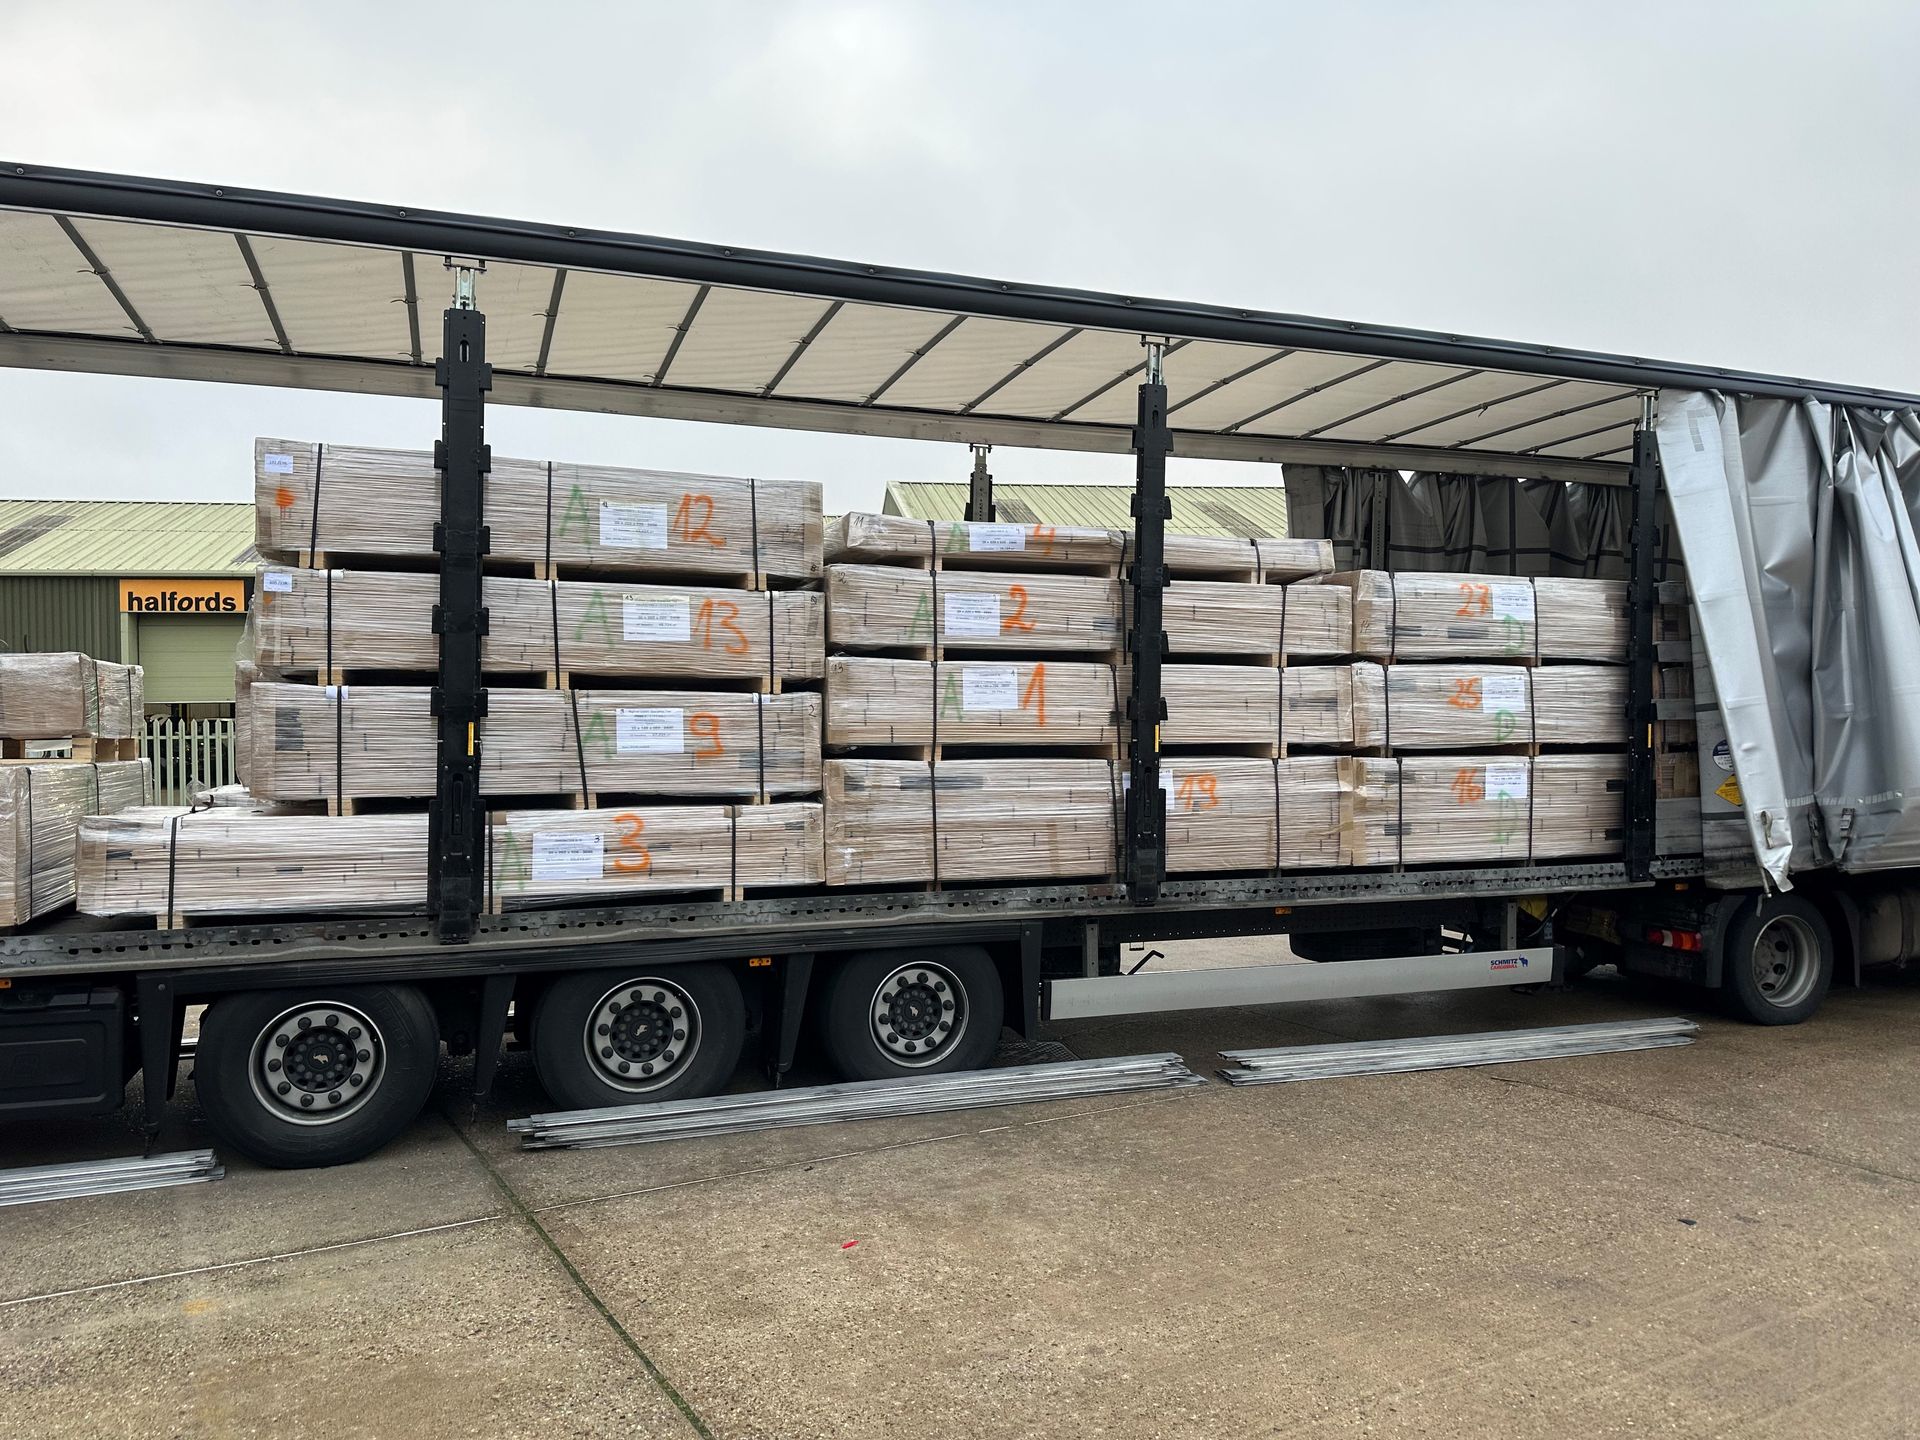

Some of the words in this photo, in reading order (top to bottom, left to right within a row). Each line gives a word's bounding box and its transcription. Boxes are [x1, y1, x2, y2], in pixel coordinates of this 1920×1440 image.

[557, 484, 592, 546] A
[673, 494, 726, 547] 12
[944, 522, 968, 552] A
[128, 592, 236, 611] halfords
[575, 588, 614, 648] A
[909, 591, 934, 640] A
[1002, 583, 1036, 632] 2
[693, 599, 751, 656] 13
[941, 672, 965, 720] A
[1022, 662, 1047, 728] 1
[581, 711, 614, 758] A
[689, 711, 725, 762] 9
[1177, 773, 1219, 810] 19
[496, 828, 527, 892] A
[612, 813, 652, 873] 3
